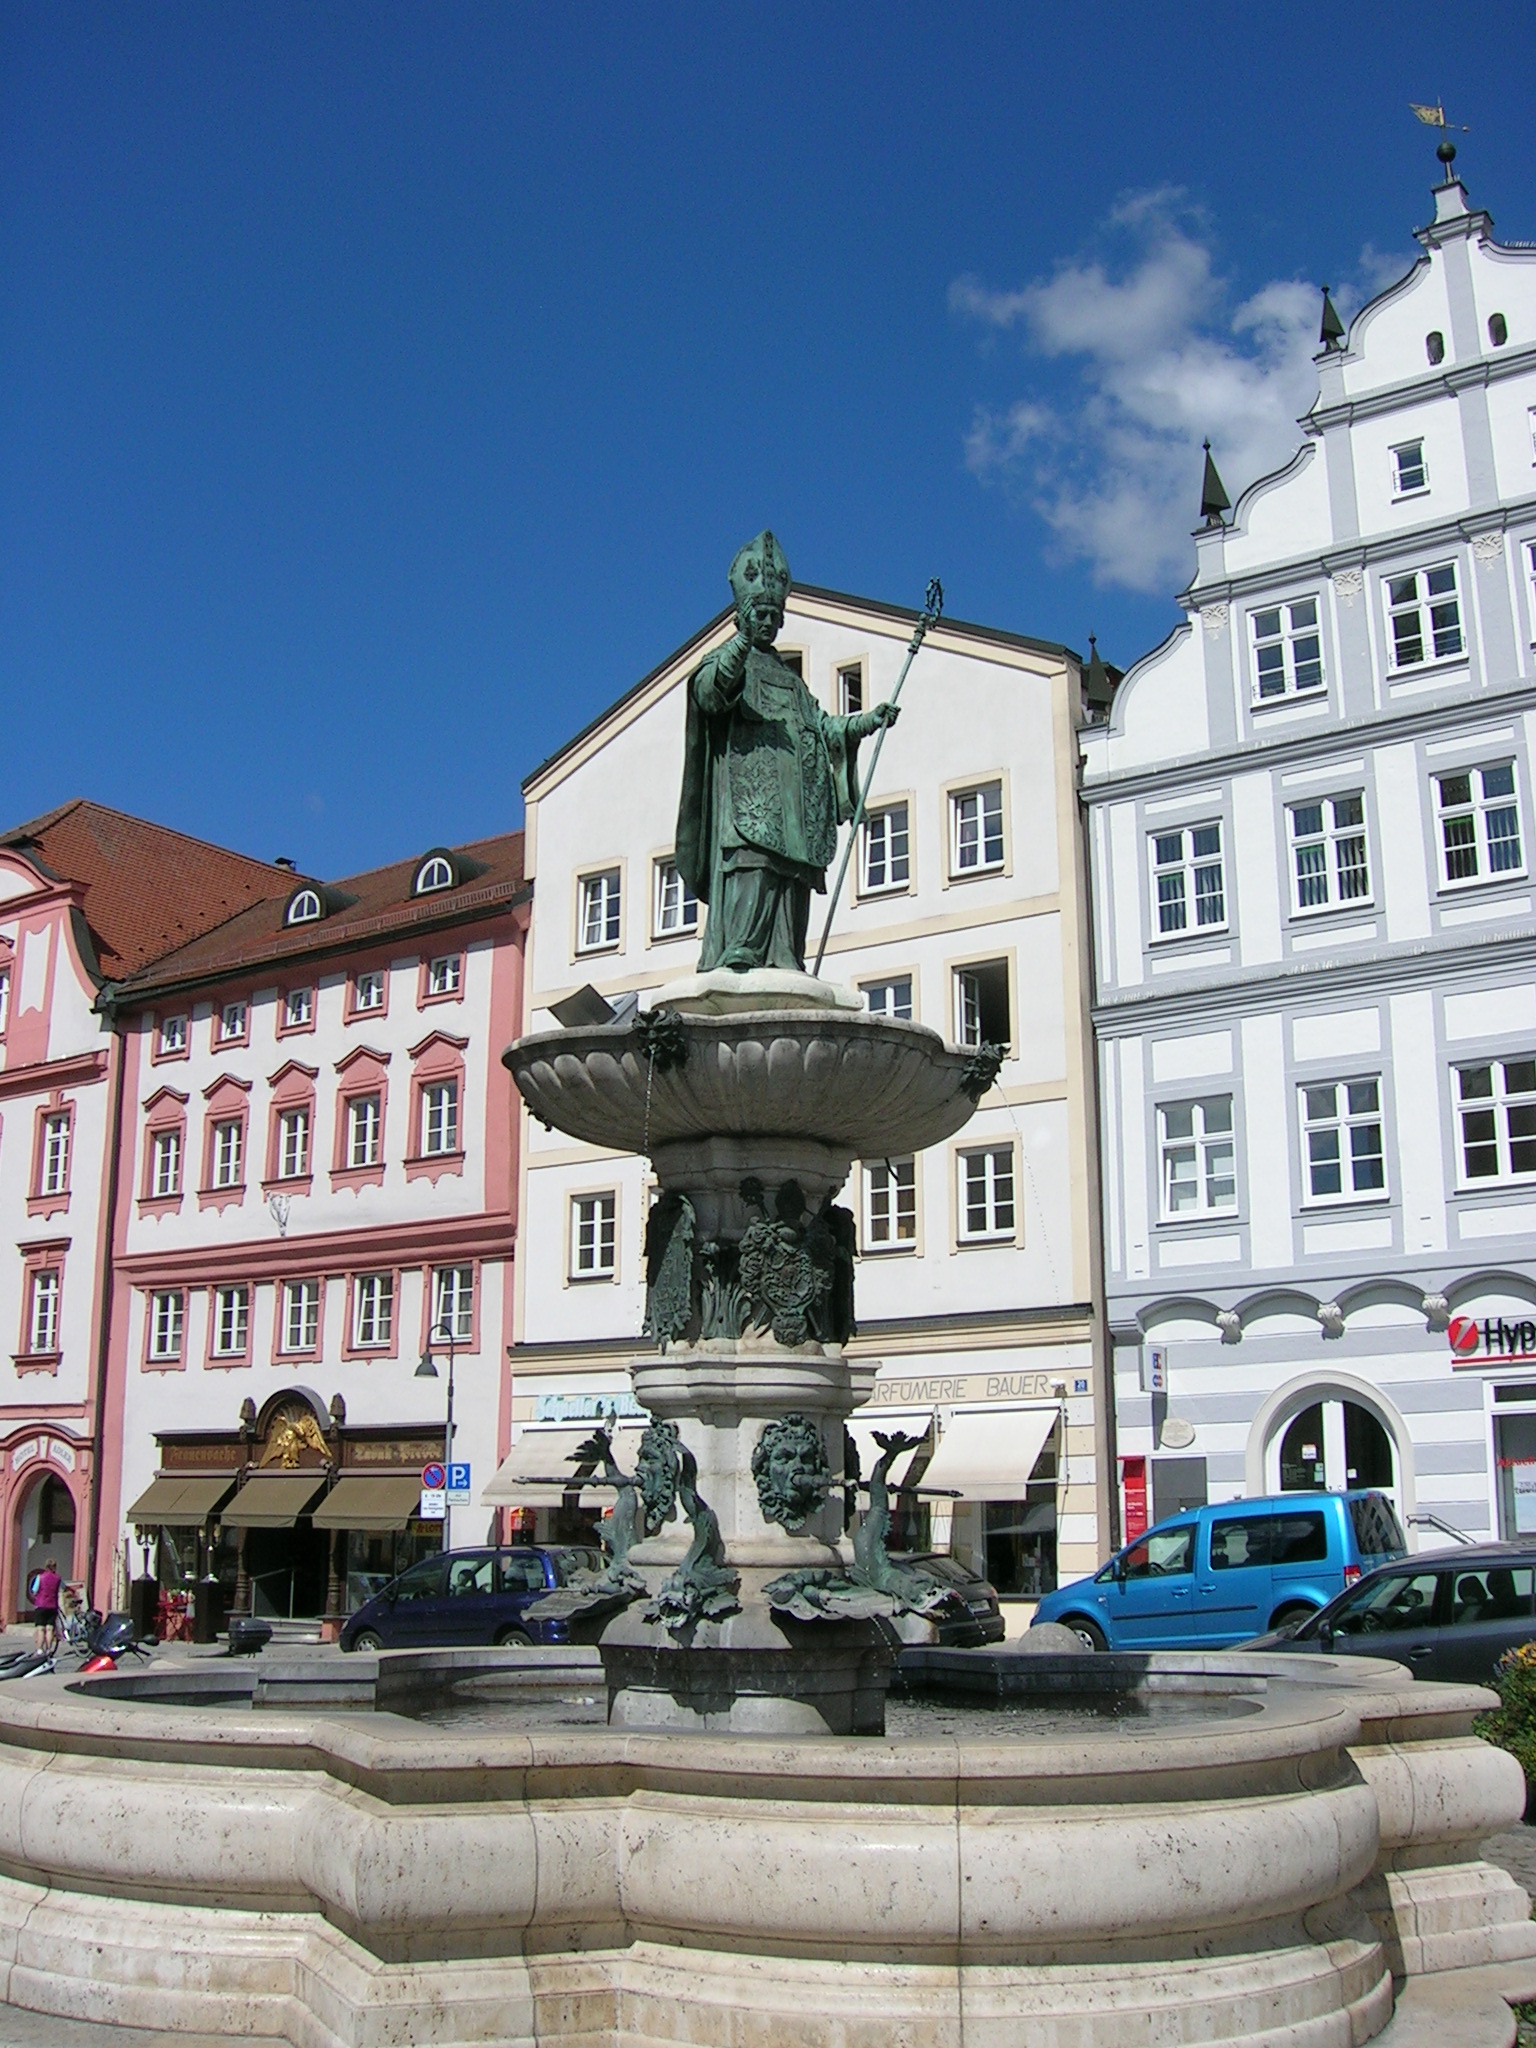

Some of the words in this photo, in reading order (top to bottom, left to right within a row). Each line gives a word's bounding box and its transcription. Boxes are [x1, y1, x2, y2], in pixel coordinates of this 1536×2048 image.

[874, 1379, 968, 1402] RFÜMERIE
[986, 1374, 1048, 1397] BAUER
[452, 1466, 466, 1488] P
